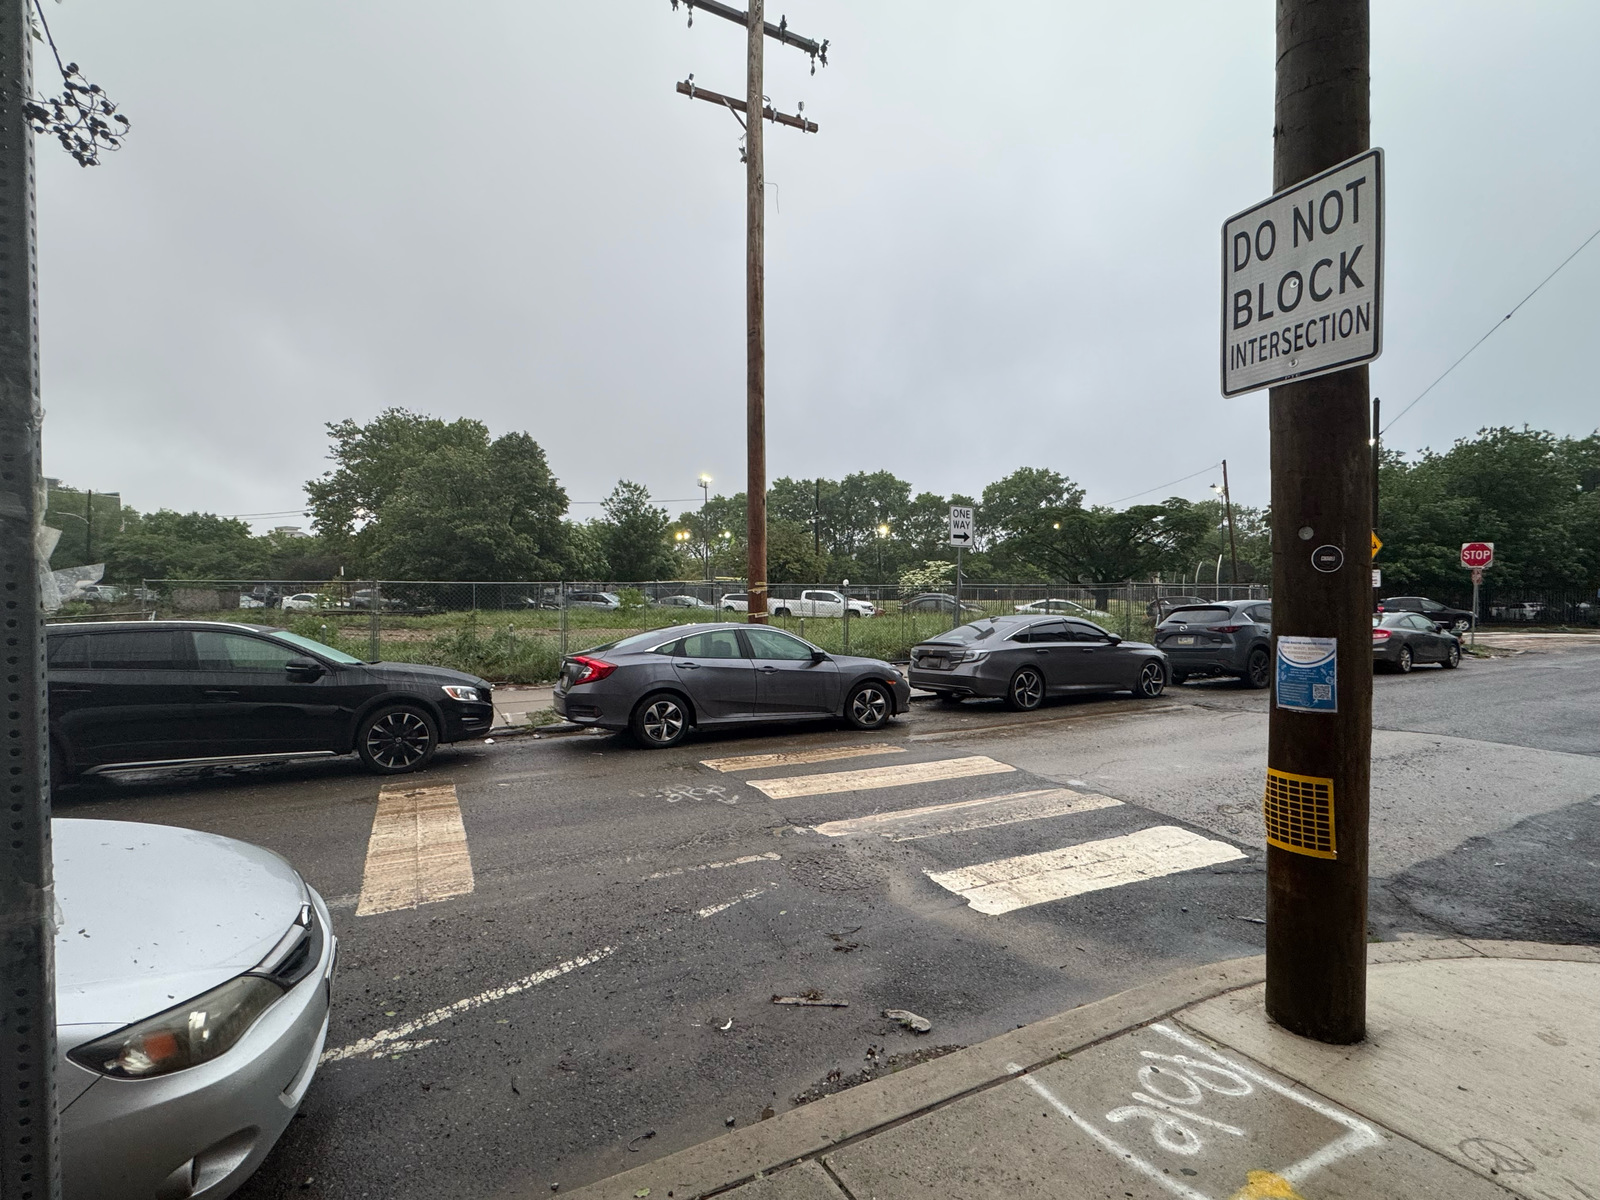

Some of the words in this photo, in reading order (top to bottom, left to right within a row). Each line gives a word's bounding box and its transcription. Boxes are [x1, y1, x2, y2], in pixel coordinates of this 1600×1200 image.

[1233, 219, 1276, 273] DO
[1293, 176, 1366, 249] NOT
[1233, 244, 1365, 330] BLOCK
[1230, 301, 1370, 371] INTERSECTION
[952, 509, 970, 519] ONE
[952, 520, 970, 530] WAY
[1463, 550, 1491, 560] STOP
